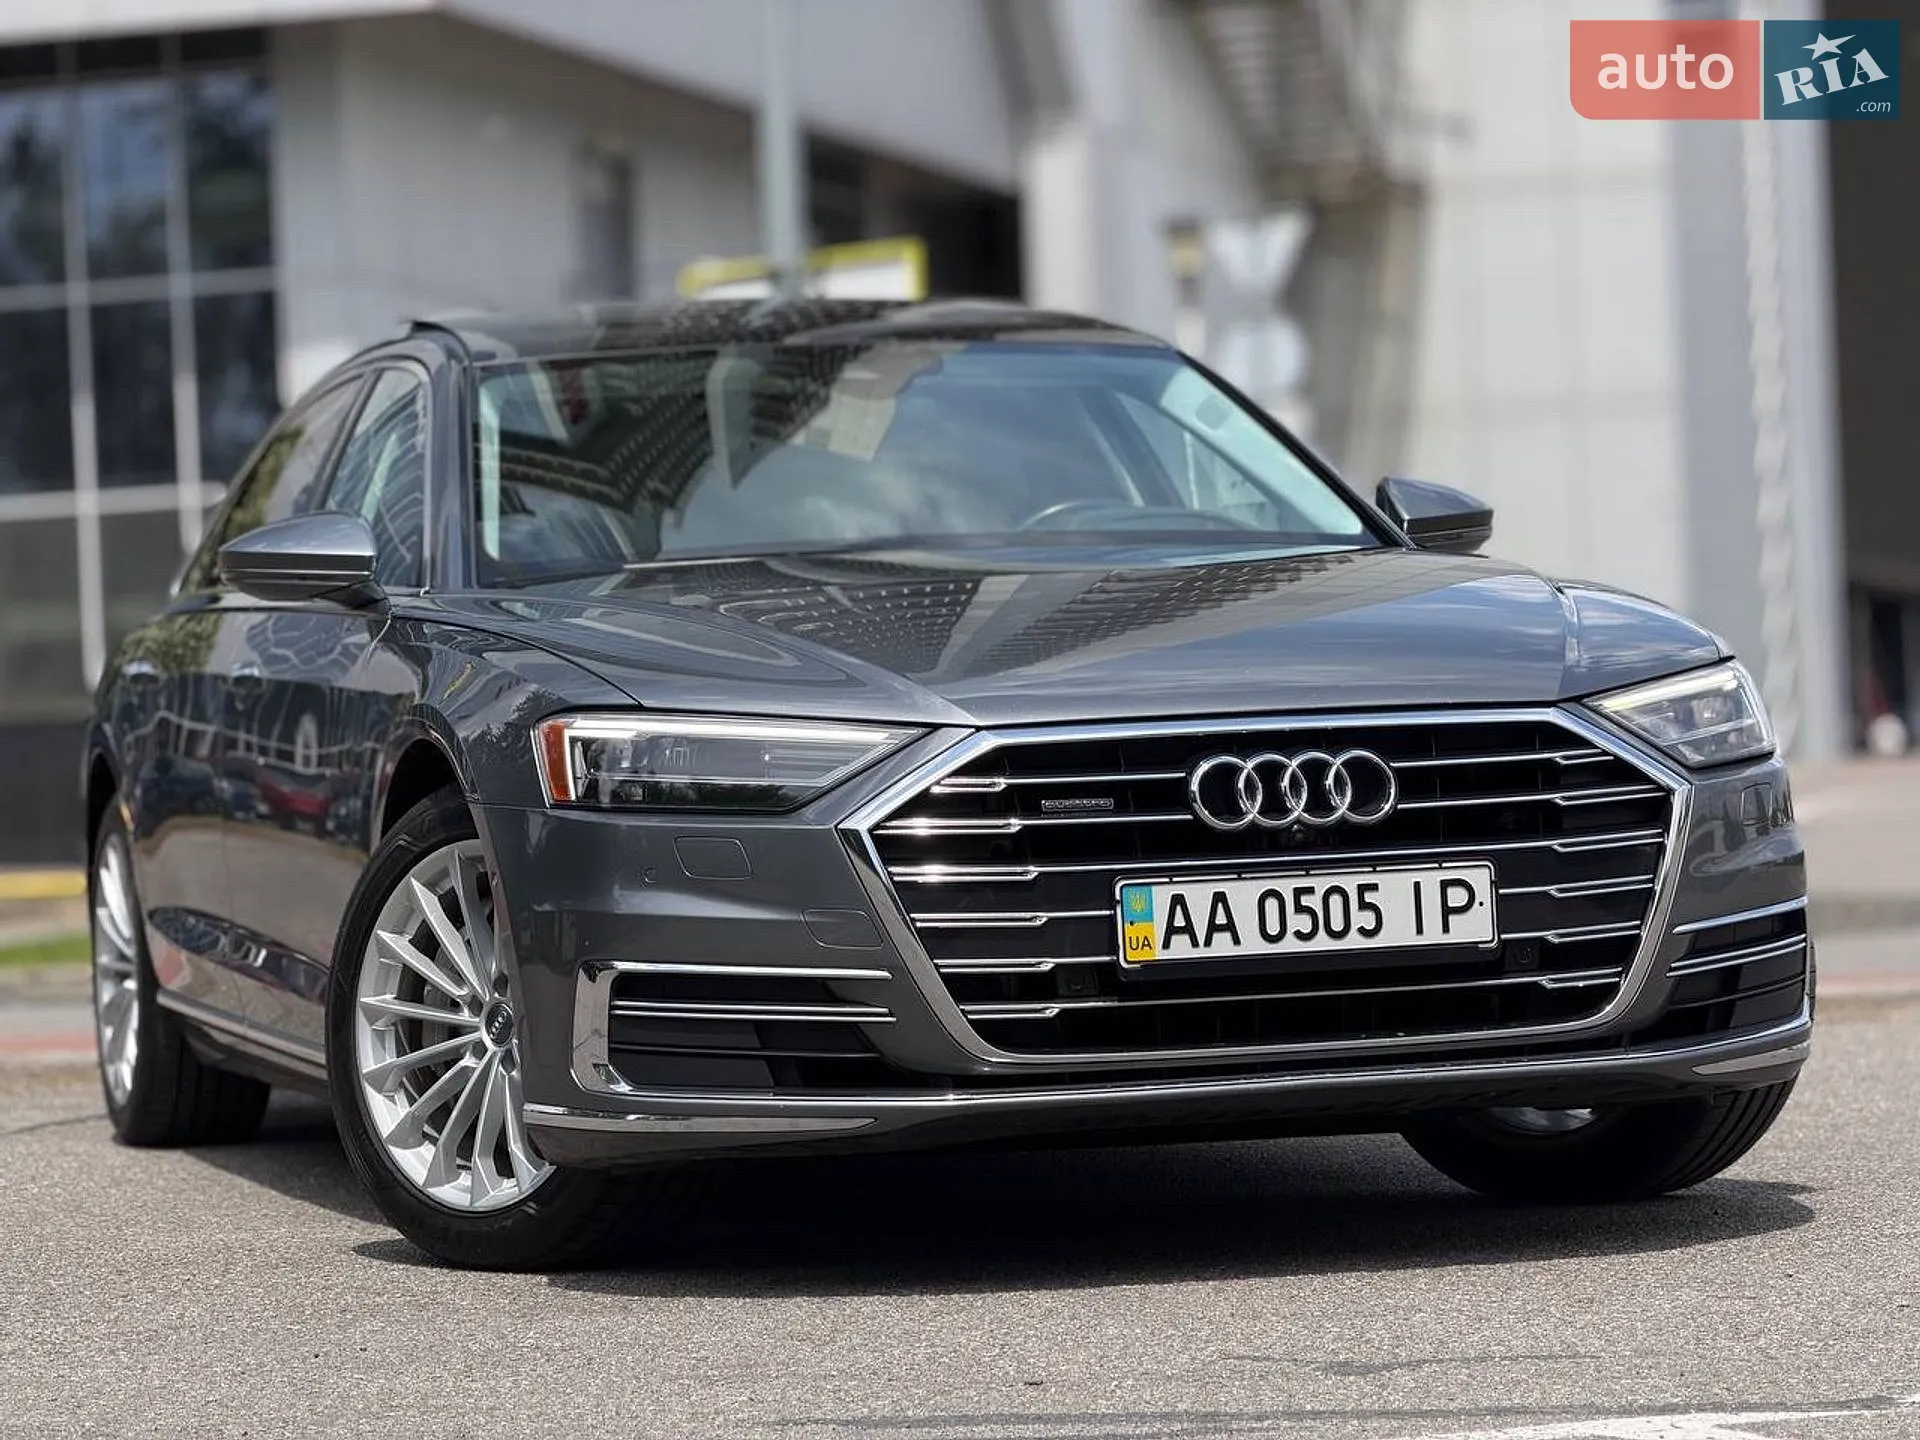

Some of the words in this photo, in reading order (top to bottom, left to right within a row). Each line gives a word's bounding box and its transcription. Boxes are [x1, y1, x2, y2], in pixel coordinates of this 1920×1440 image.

[1162, 891, 1242, 949] AA
[1257, 883, 1383, 943] 0505
[1413, 878, 1476, 936] IP
[1129, 935, 1152, 952] UA
